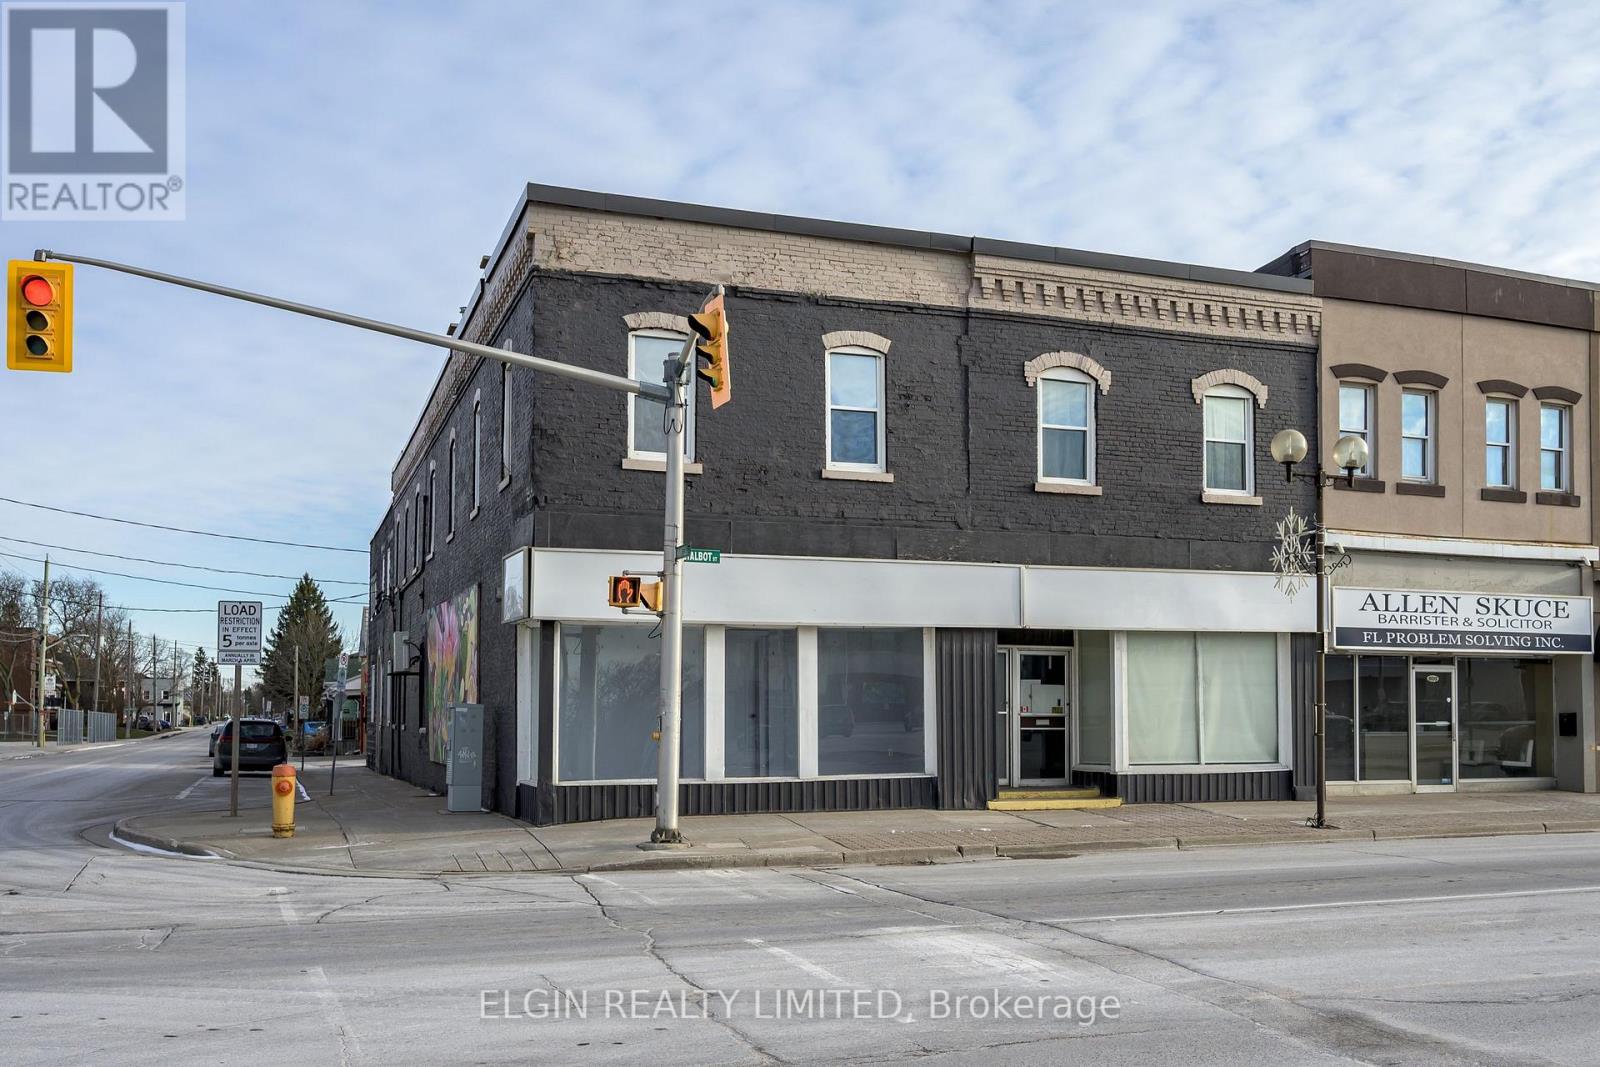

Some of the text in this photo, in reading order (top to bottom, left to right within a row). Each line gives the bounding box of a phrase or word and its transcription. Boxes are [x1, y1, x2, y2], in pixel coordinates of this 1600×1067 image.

[687, 551, 713, 562] ALBOT
[224, 605, 256, 615] LOAD
[1358, 592, 1570, 619] ALLEN SKUCE
[220, 617, 260, 625] RESTRICTION
[1378, 613, 1553, 630] BARRISTER & SOLICITOR
[223, 634, 232, 647] 5
[1362, 631, 1565, 649] FL PROBLEM SOLVING INC.
